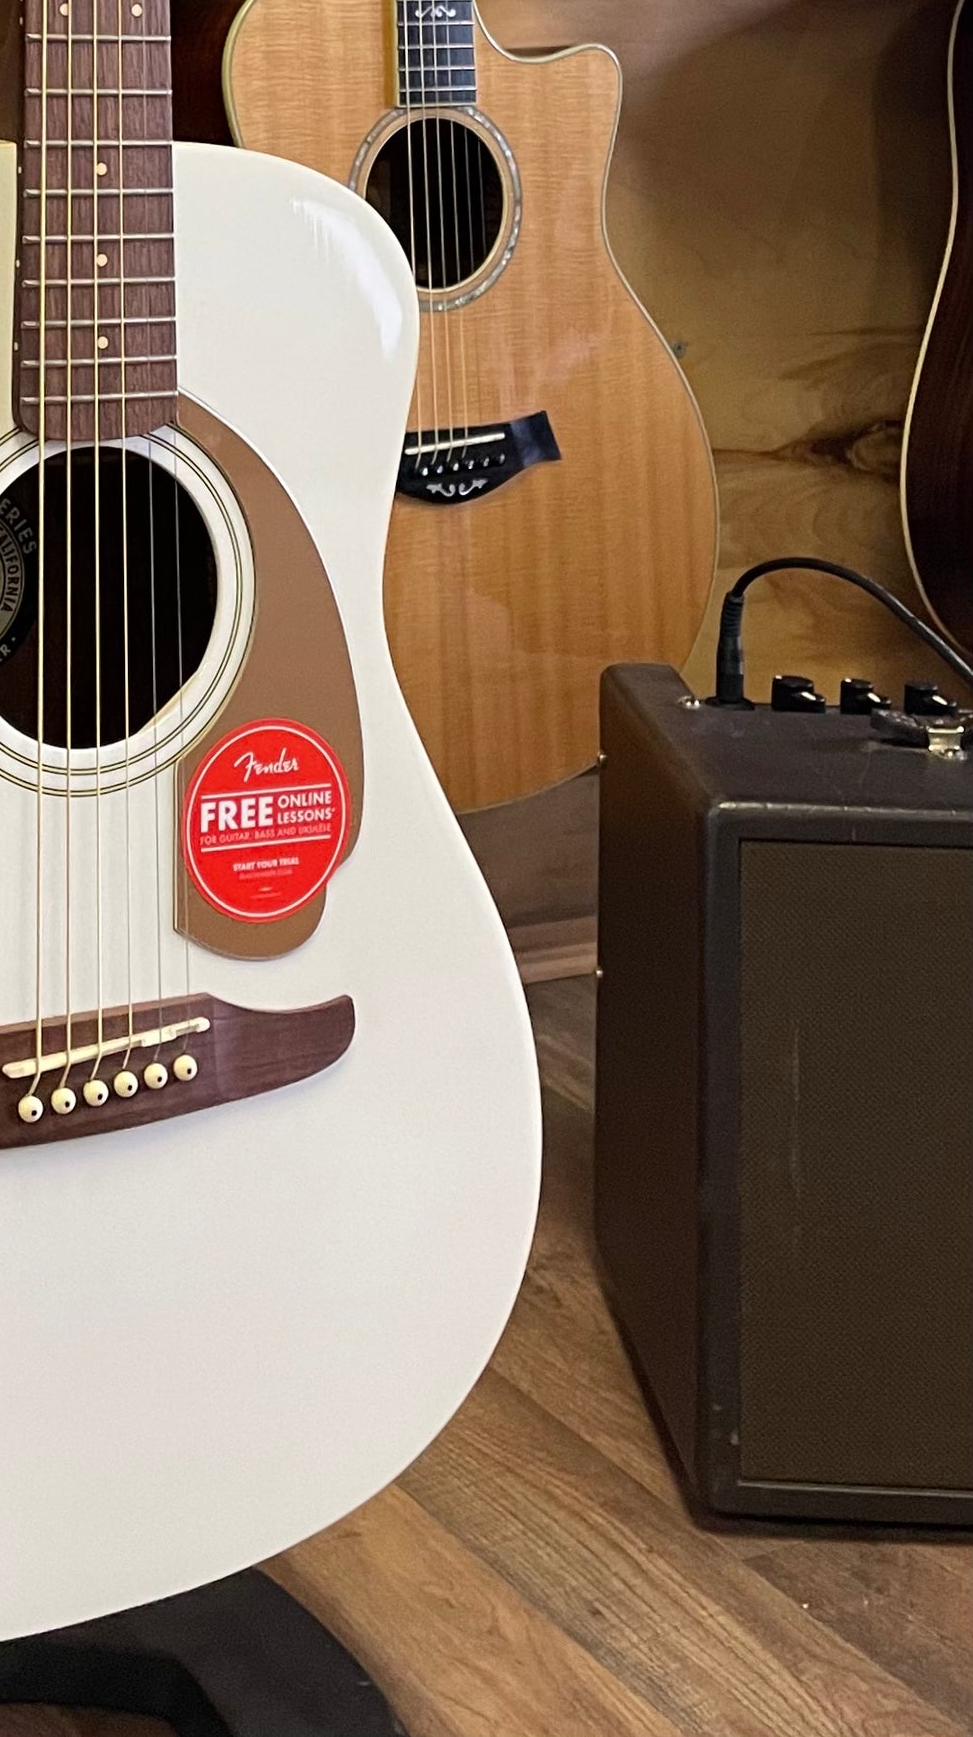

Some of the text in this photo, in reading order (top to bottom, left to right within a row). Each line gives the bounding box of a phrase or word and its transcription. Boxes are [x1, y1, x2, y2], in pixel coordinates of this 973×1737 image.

[234, 747, 299, 782] Fender
[277, 790, 332, 809] ONLINE
[200, 796, 274, 833] FREE
[200, 833, 217, 845] FOR
[255, 828, 275, 839] BASS
[277, 826, 297, 837] AND
[233, 857, 299, 872] START YOUR TRIAL
